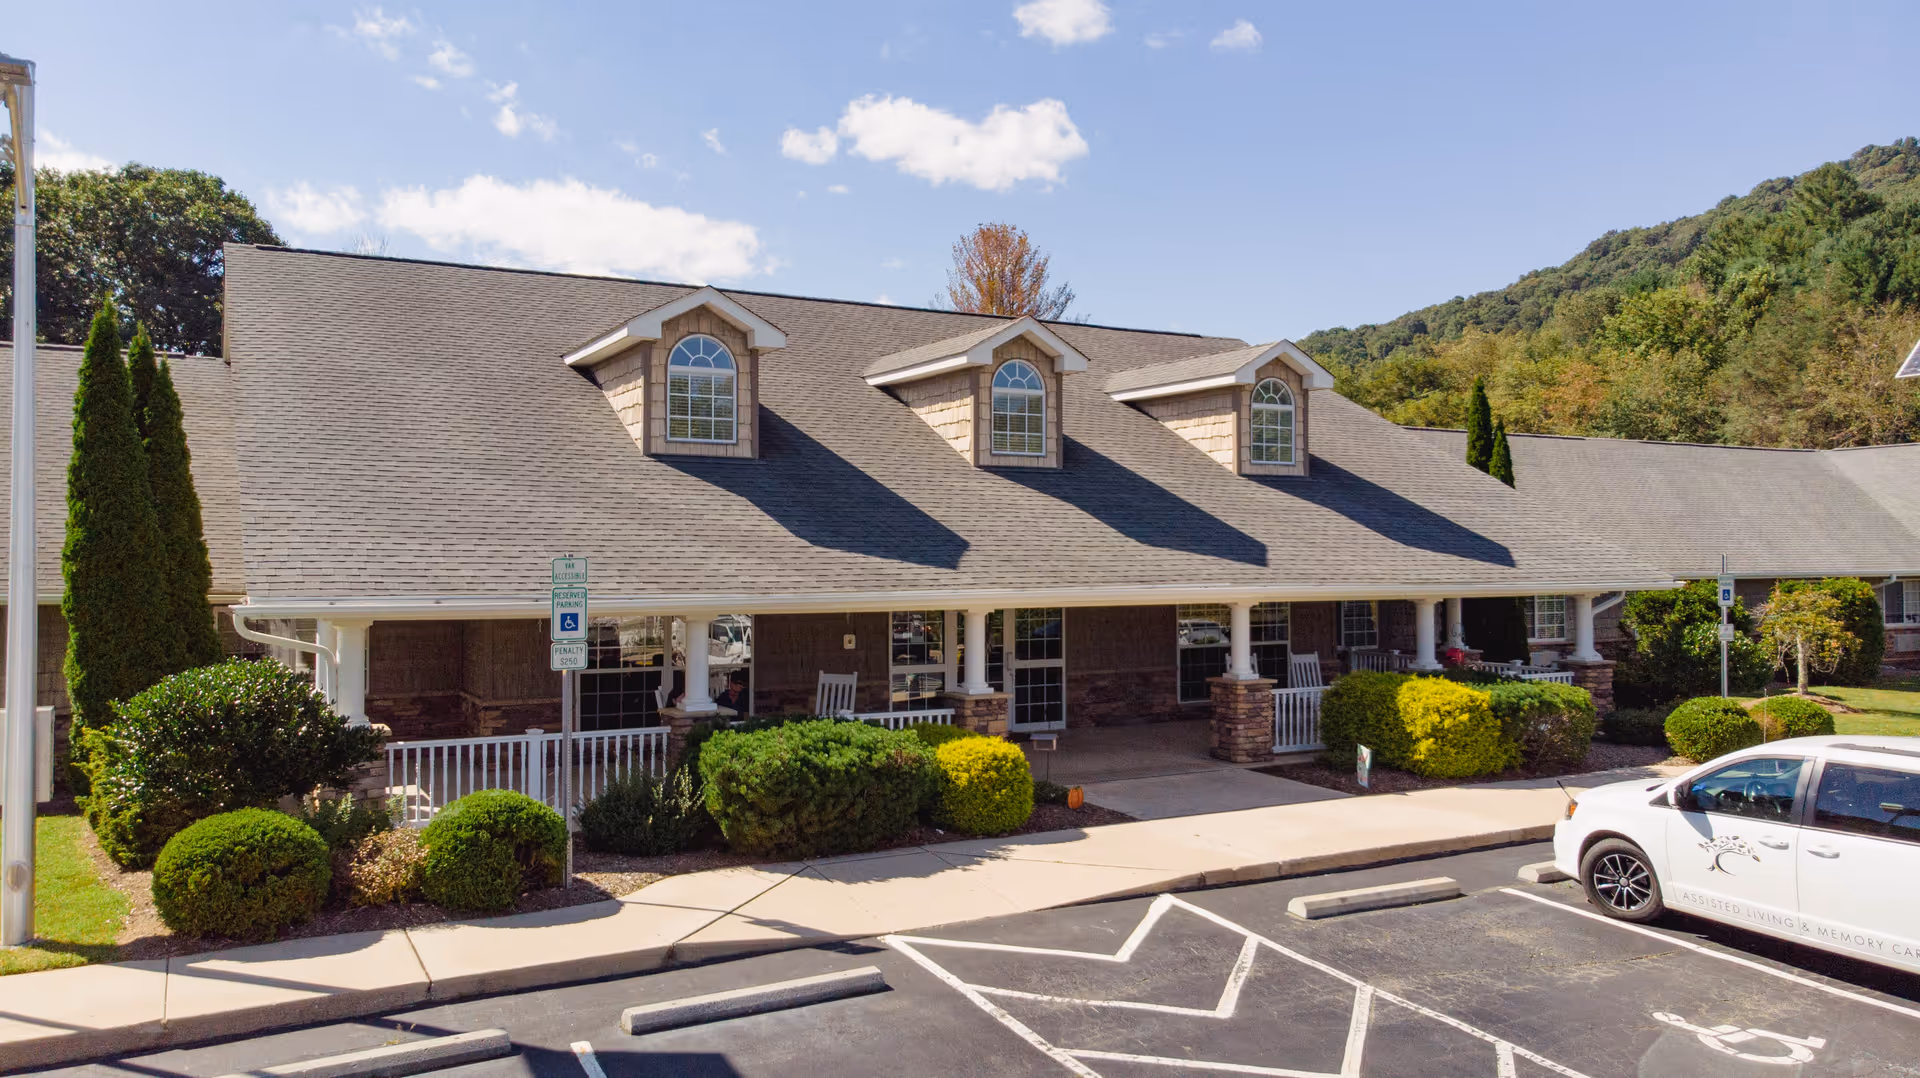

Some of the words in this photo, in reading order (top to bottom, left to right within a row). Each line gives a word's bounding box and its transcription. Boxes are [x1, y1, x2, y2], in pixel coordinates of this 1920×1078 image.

[555, 647, 584, 655] PENALTY
[560, 658, 578, 666] $250
[1682, 892, 1740, 914] ASSISTED
[1746, 910, 1794, 928] LIVING
[1801, 922, 1811, 933] &
[1817, 927, 1884, 950] MEMORY
